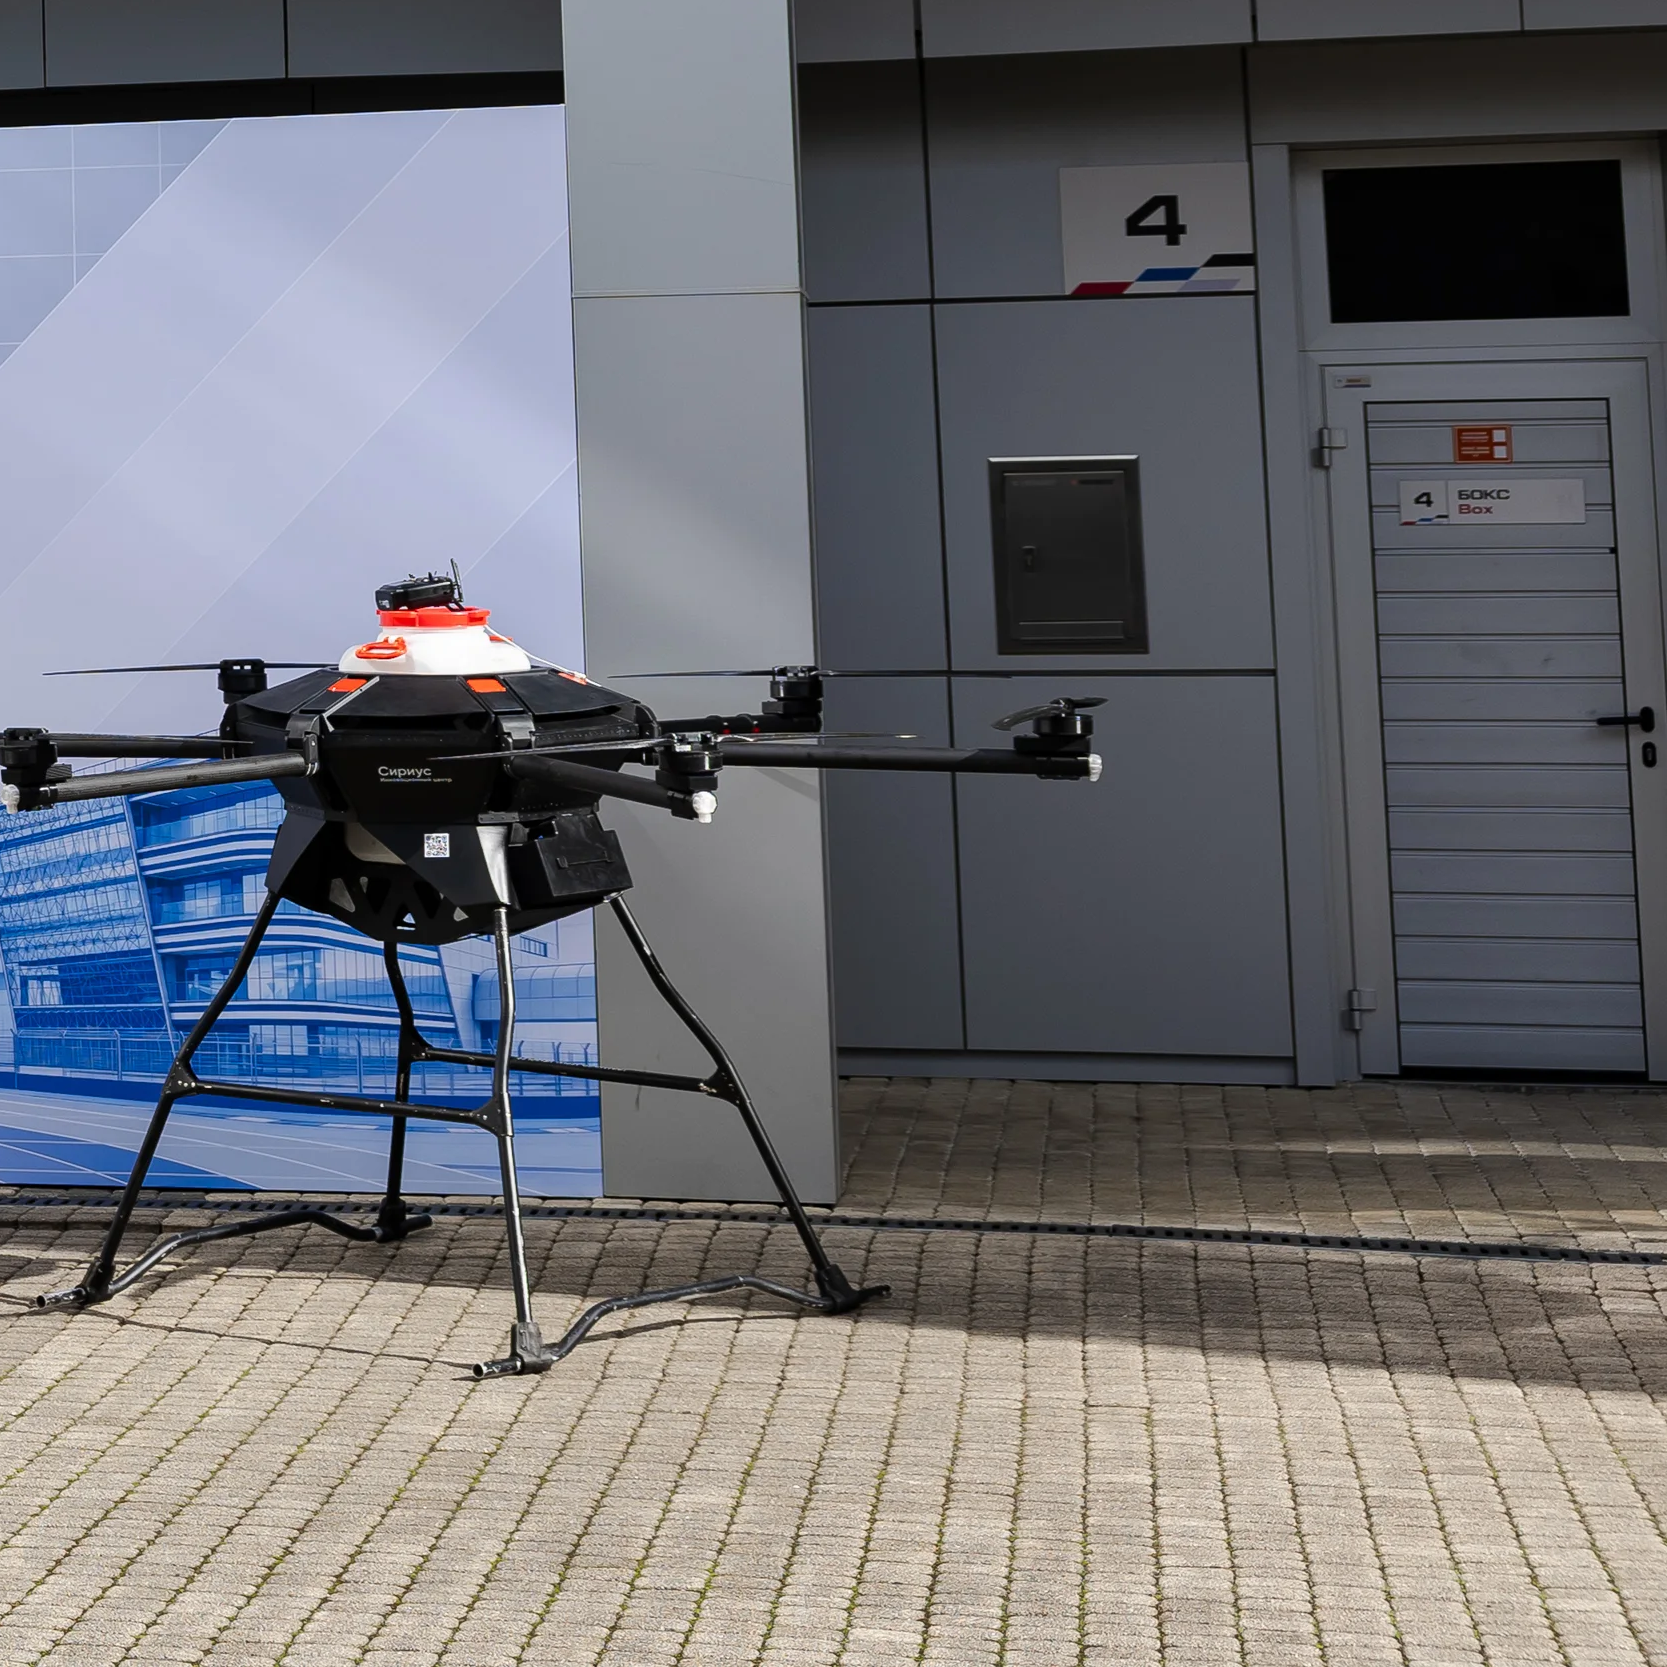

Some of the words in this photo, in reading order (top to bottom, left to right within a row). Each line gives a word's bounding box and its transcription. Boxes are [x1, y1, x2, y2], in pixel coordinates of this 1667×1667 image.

[1124, 193, 1188, 247] 4
[1413, 491, 1434, 508] 4
[1456, 488, 1511, 501] БОКС
[1457, 502, 1494, 515] Box
[377, 765, 432, 778] Сириус
